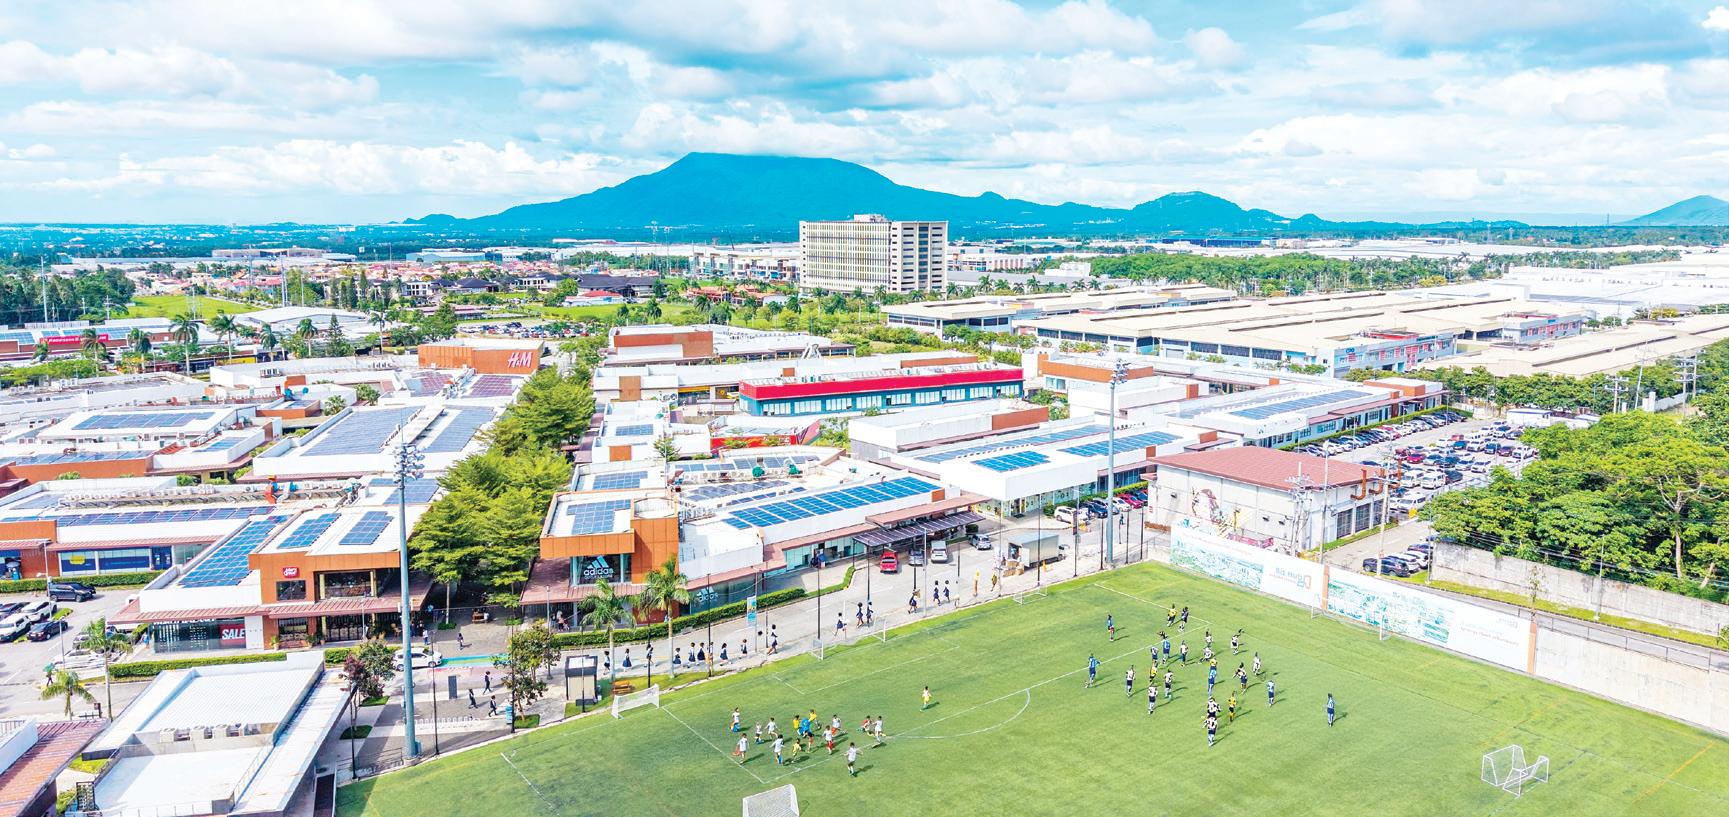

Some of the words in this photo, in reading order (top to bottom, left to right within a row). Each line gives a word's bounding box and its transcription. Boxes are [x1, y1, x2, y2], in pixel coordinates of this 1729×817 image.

[507, 351, 533, 369] H&M
[583, 568, 614, 576] adidas
[222, 628, 245, 640] SALE
